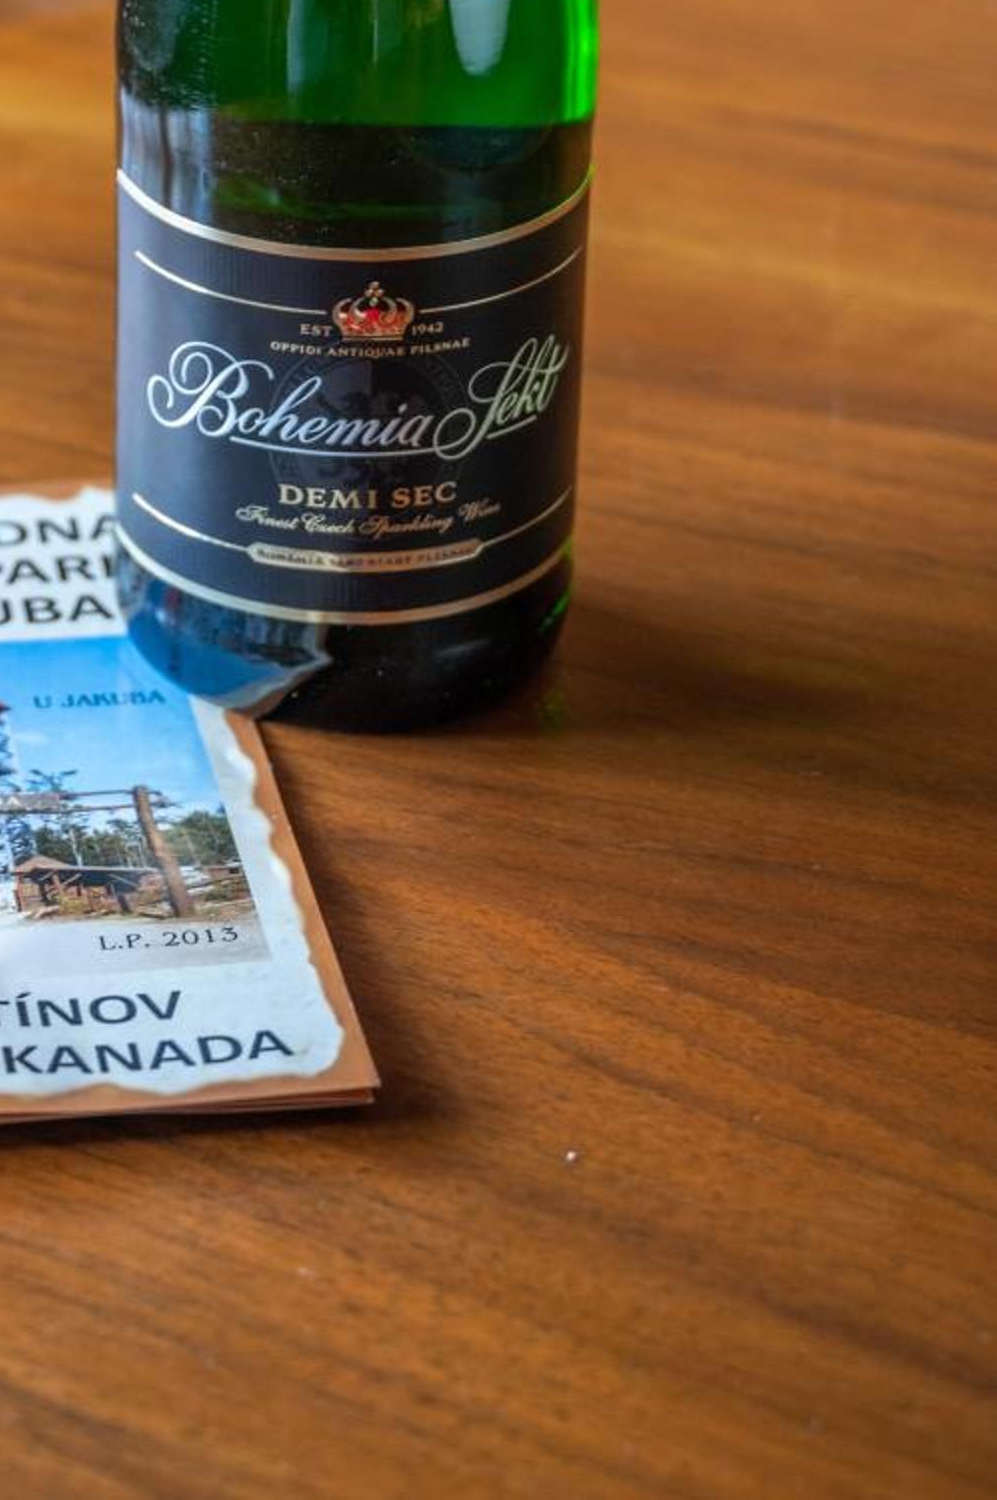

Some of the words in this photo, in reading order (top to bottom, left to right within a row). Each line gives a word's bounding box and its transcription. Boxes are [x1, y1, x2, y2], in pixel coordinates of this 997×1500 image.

[300, 323, 332, 337] EST
[270, 340, 322, 355] OPPIDI
[325, 345, 405, 358] ANTIQUAE
[147, 341, 434, 450] Bohemia
[434, 334, 569, 460] Sekt
[278, 483, 377, 509] DEMI
[390, 481, 457, 508] SEC
[33, 696, 51, 708] U
[61, 691, 166, 707] JAKUBA
[99, 933, 150, 951] L.P.
[163, 927, 239, 947] 2013
[2, 1029, 295, 1075] KANADA
